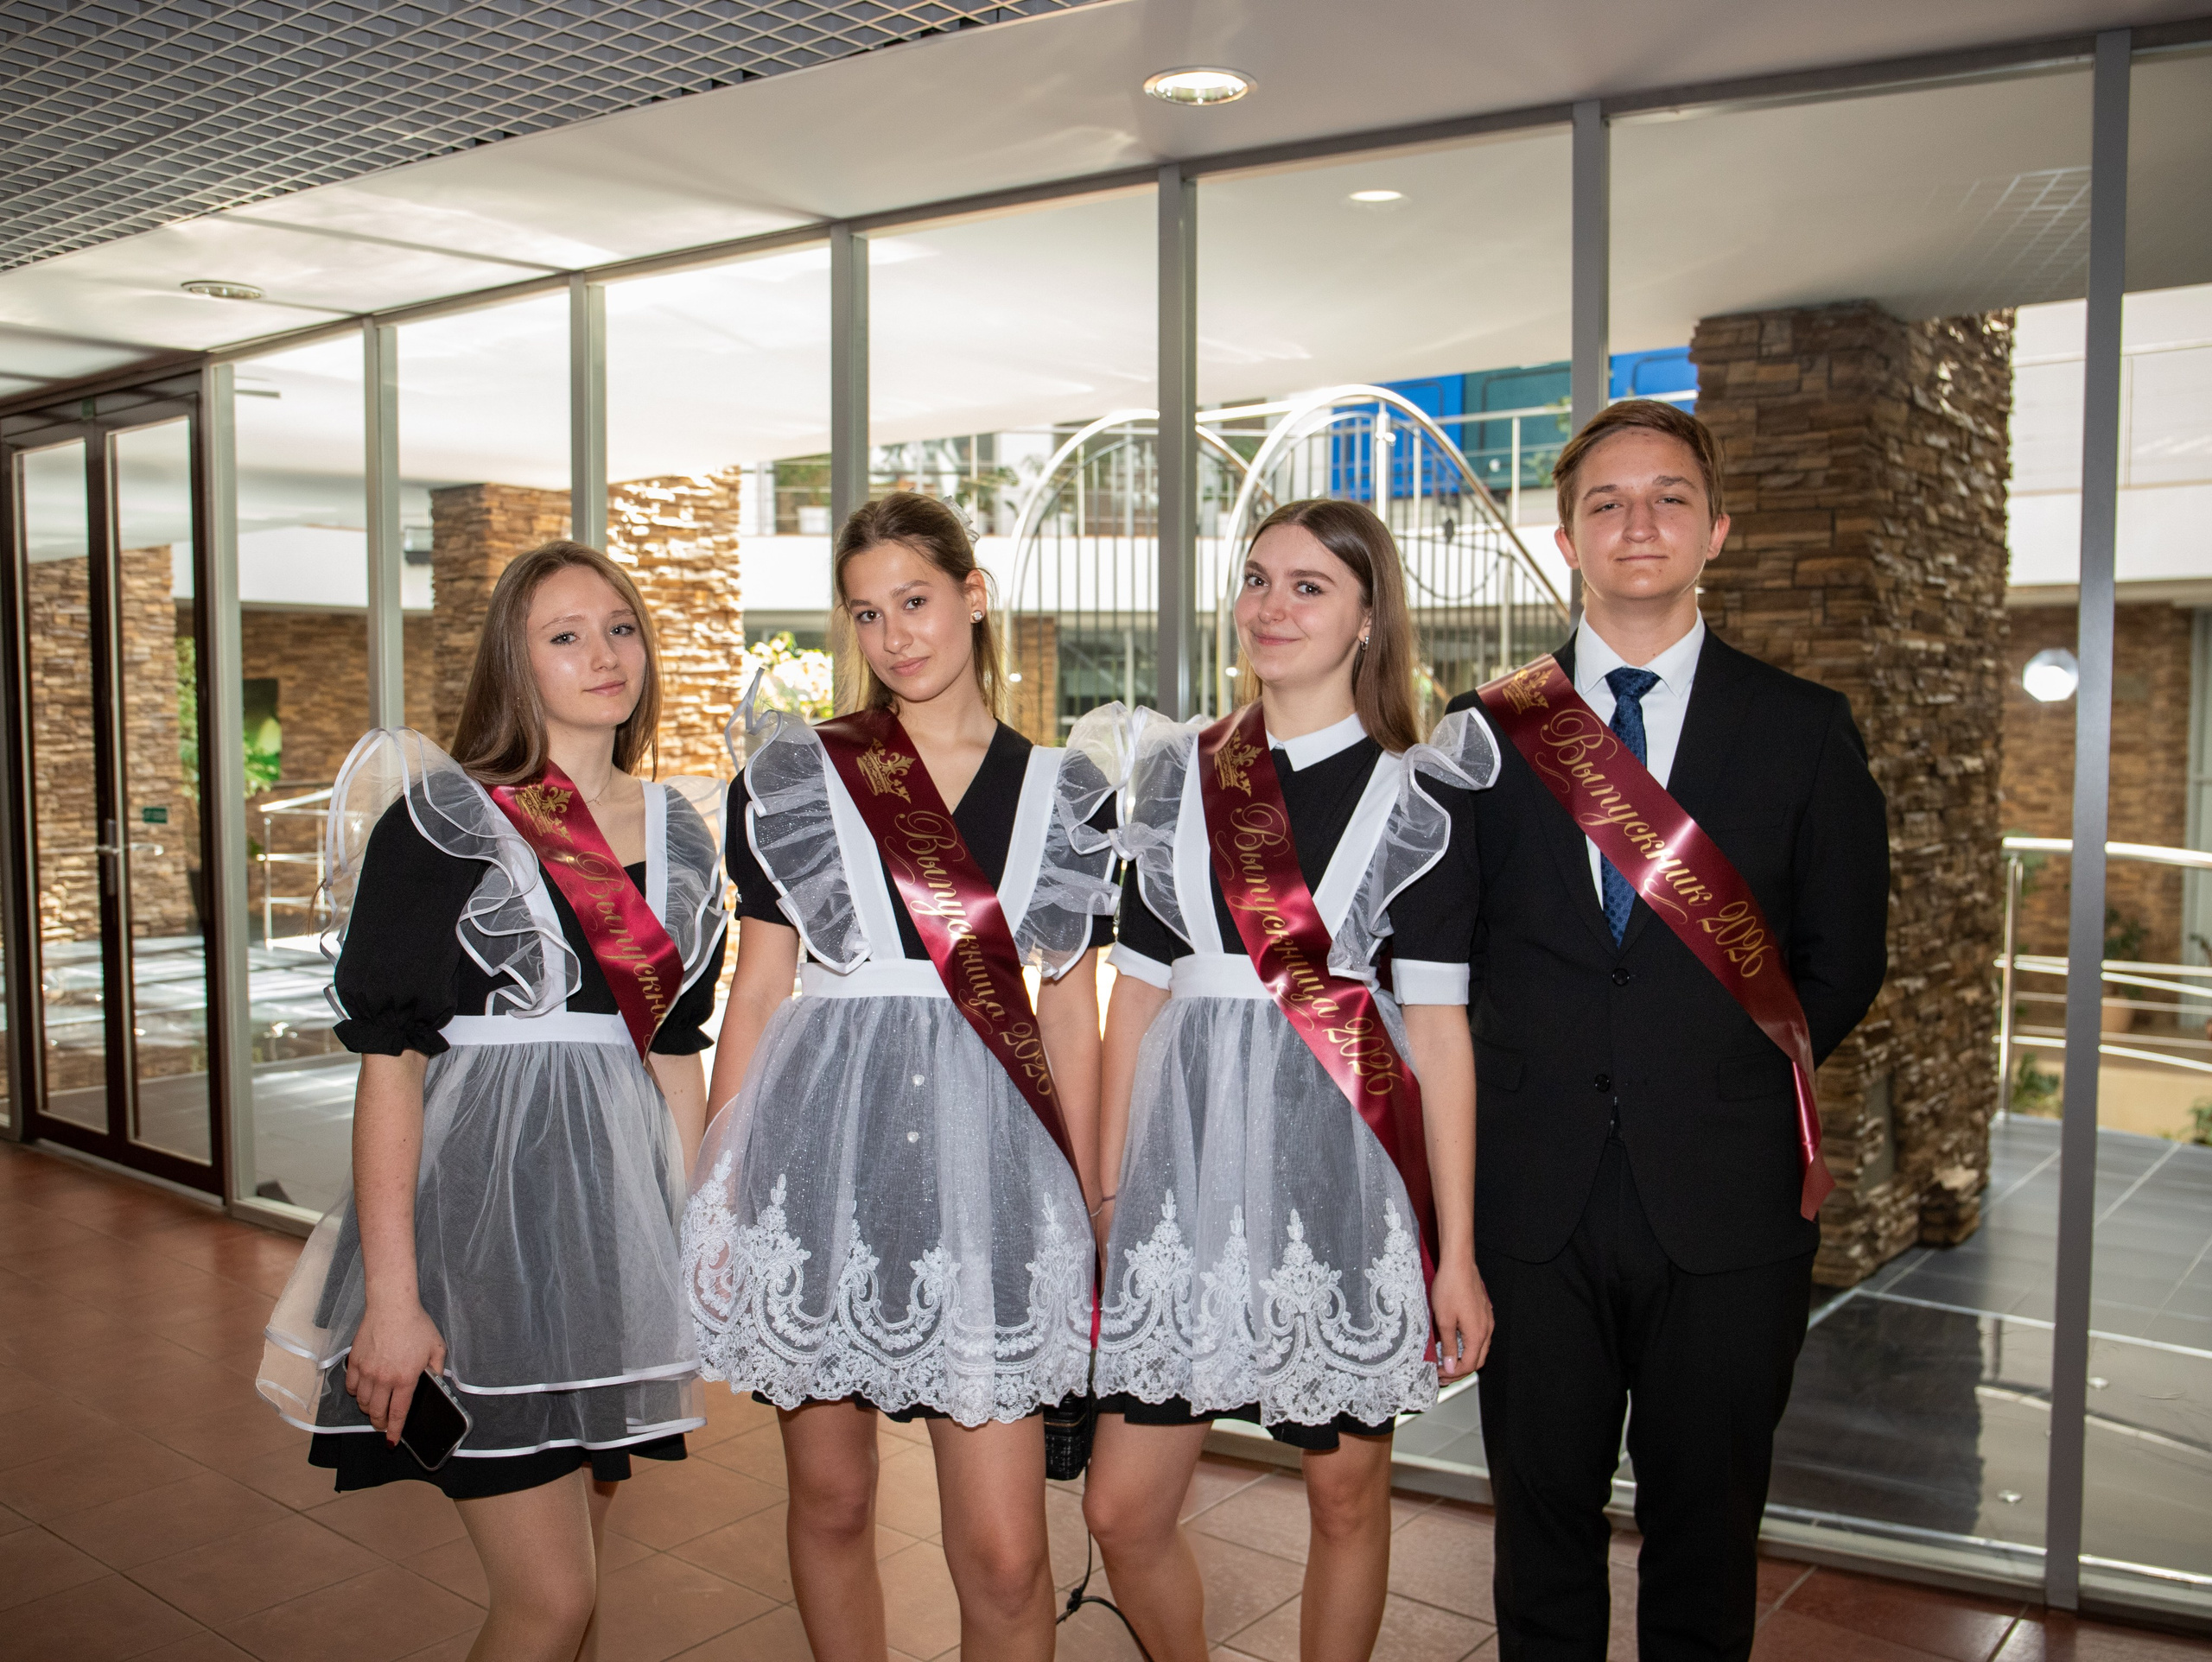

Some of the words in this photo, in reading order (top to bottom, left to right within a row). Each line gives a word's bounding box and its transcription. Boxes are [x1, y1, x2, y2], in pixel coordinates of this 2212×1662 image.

[888, 810, 1007, 1024] Выпускница
[1217, 802, 1340, 1021] Выпускница
[1322, 1017, 1405, 1095] 2026
[1537, 708, 1713, 910] Выпускник
[1696, 901, 1774, 978] 2026
